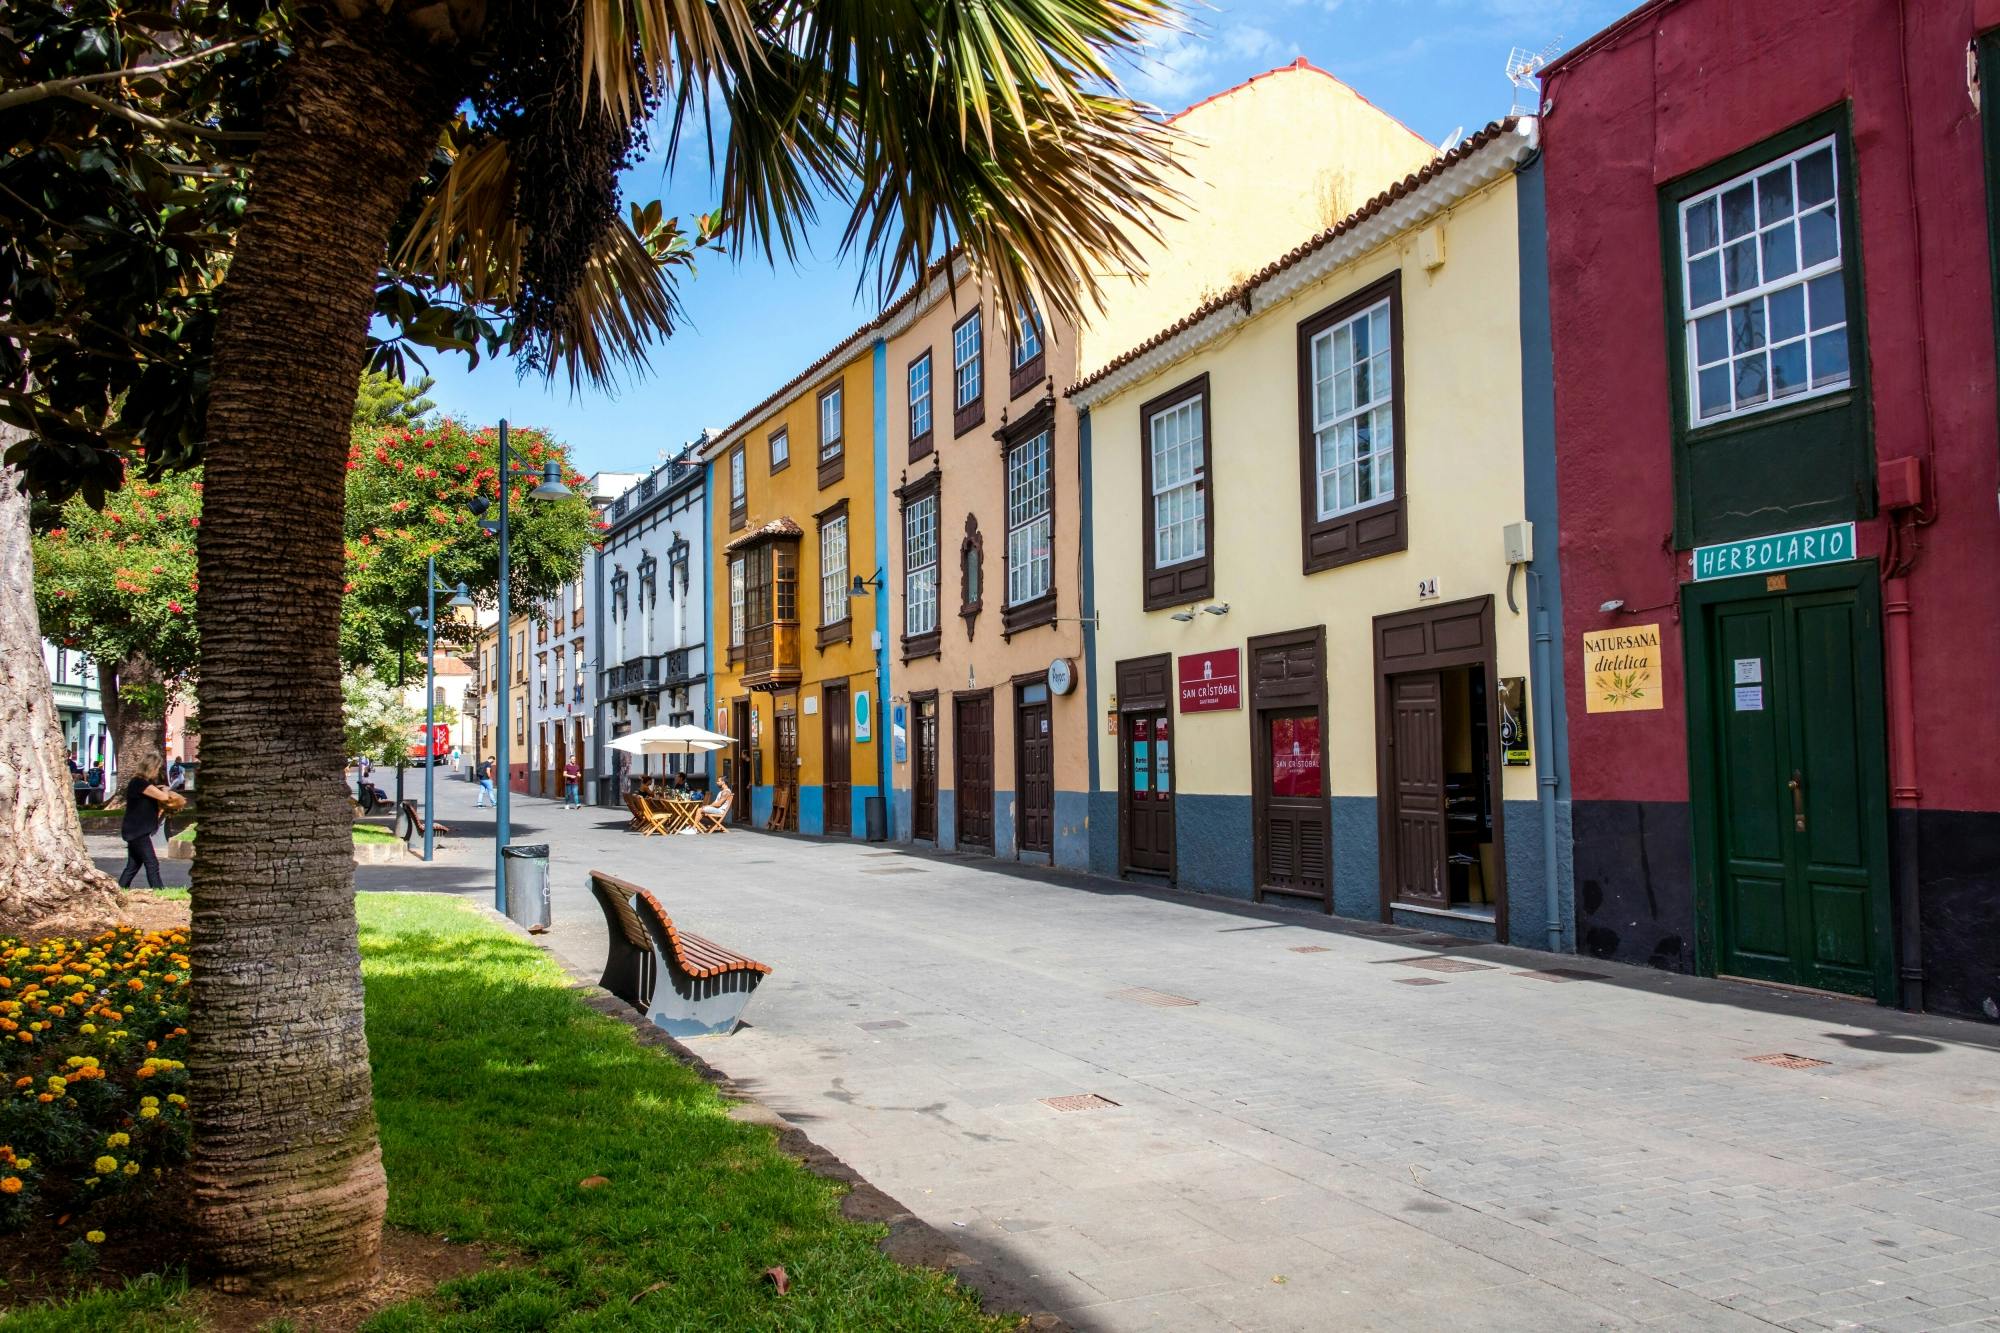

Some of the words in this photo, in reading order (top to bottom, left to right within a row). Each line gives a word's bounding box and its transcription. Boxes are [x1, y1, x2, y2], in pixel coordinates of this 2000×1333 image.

[1703, 532, 1843, 575] HERBOLARIO
[1419, 579, 1435, 598] 24
[1585, 632, 1659, 653] NATUR-SANA
[1182, 688, 1196, 699] SAN
[1276, 760, 1287, 768] SAN
